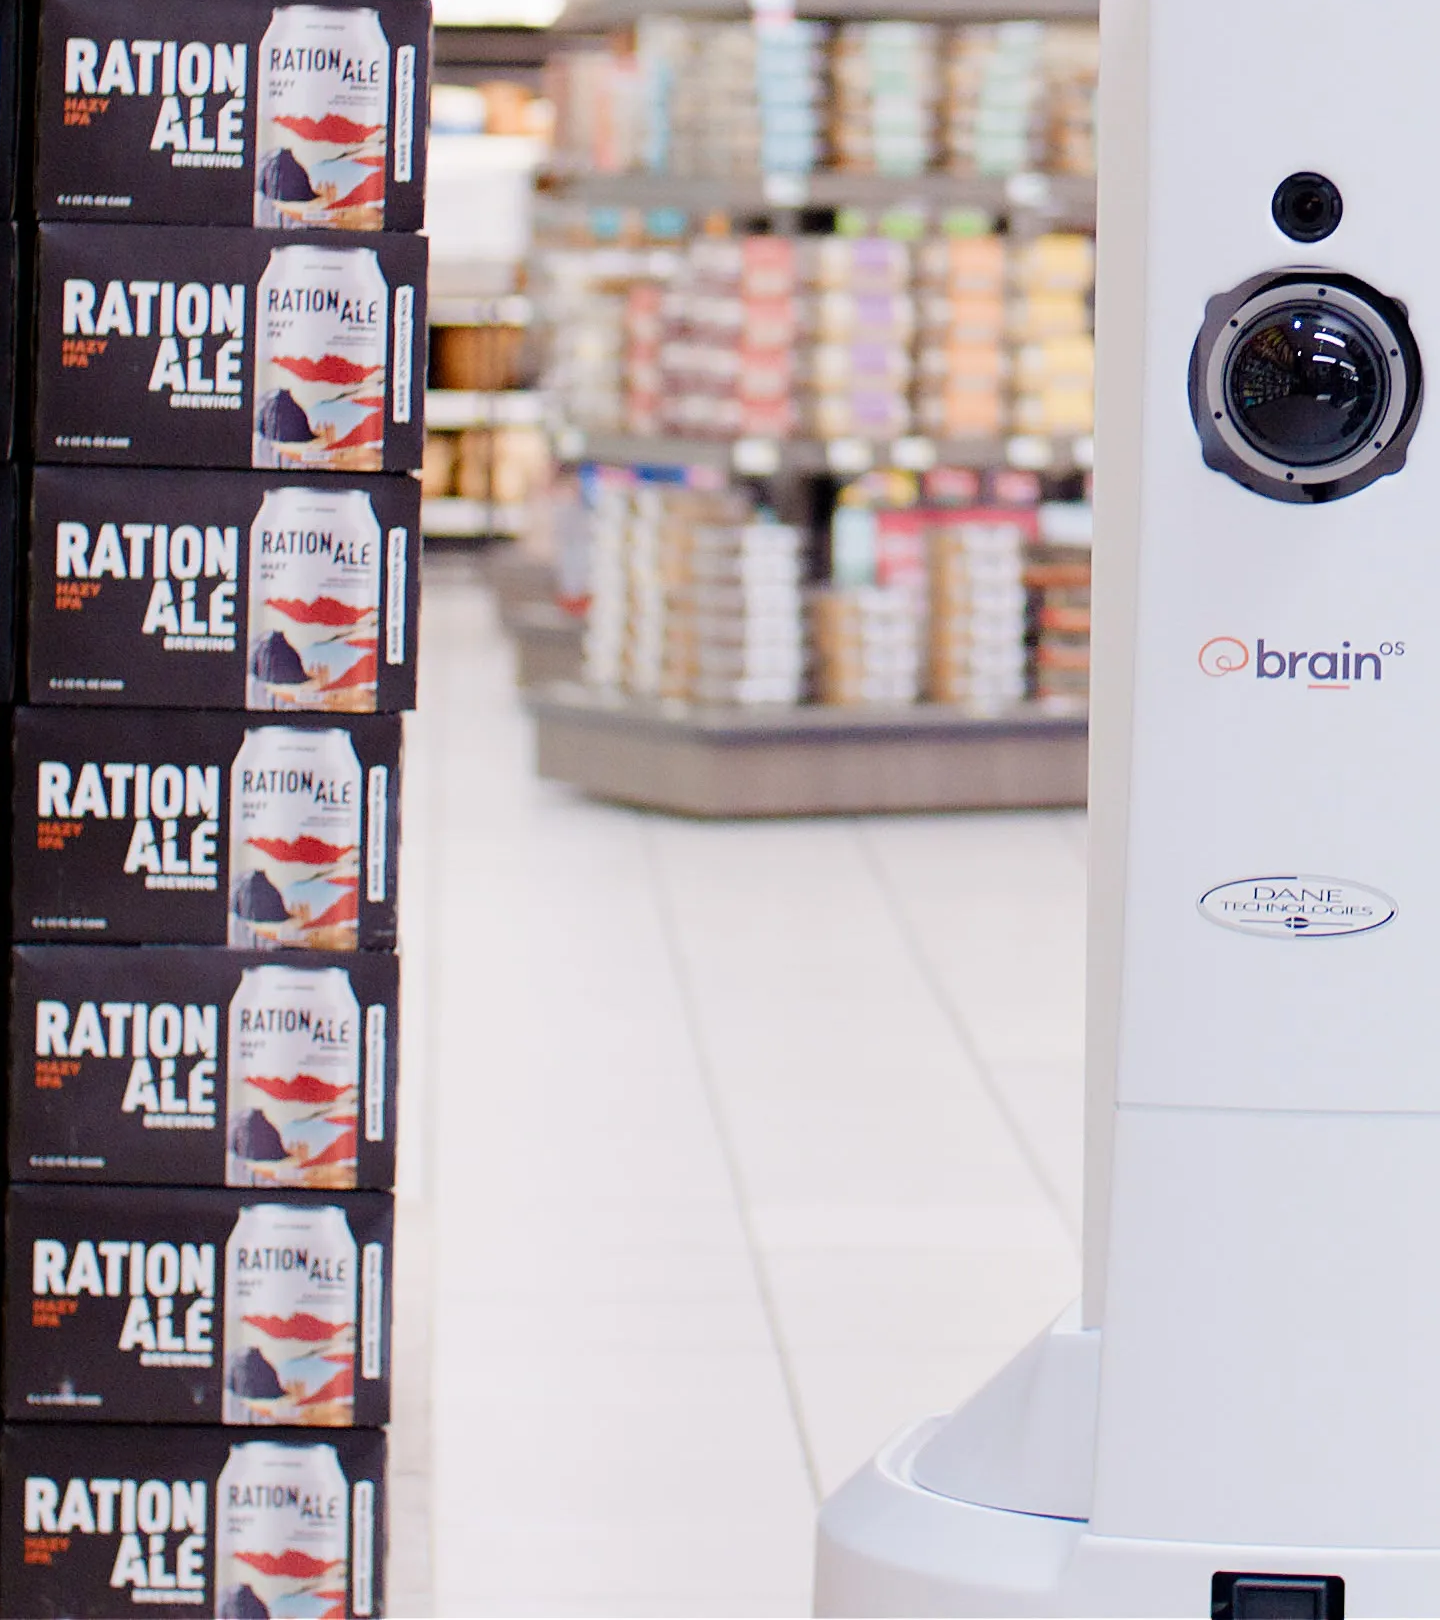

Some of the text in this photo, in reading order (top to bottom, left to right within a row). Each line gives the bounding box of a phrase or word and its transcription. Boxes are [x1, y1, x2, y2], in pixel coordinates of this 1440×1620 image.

[64, 37, 247, 96] RATION
[149, 95, 246, 152] ALE
[62, 278, 245, 337] RATION
[147, 336, 244, 393] ALE
[56, 521, 239, 580] RATION
[141, 579, 238, 636] ALE
[37, 760, 220, 819] RATION
[122, 818, 219, 875] ALE
[1221, 901, 1373, 917] TECHNOLOGIES
[1253, 886, 1343, 904] DANE
[35, 999, 218, 1058] RATION
[120, 1057, 217, 1114] ALE
[24, 1475, 207, 1534] RATION
[109, 1533, 206, 1590] ALE
